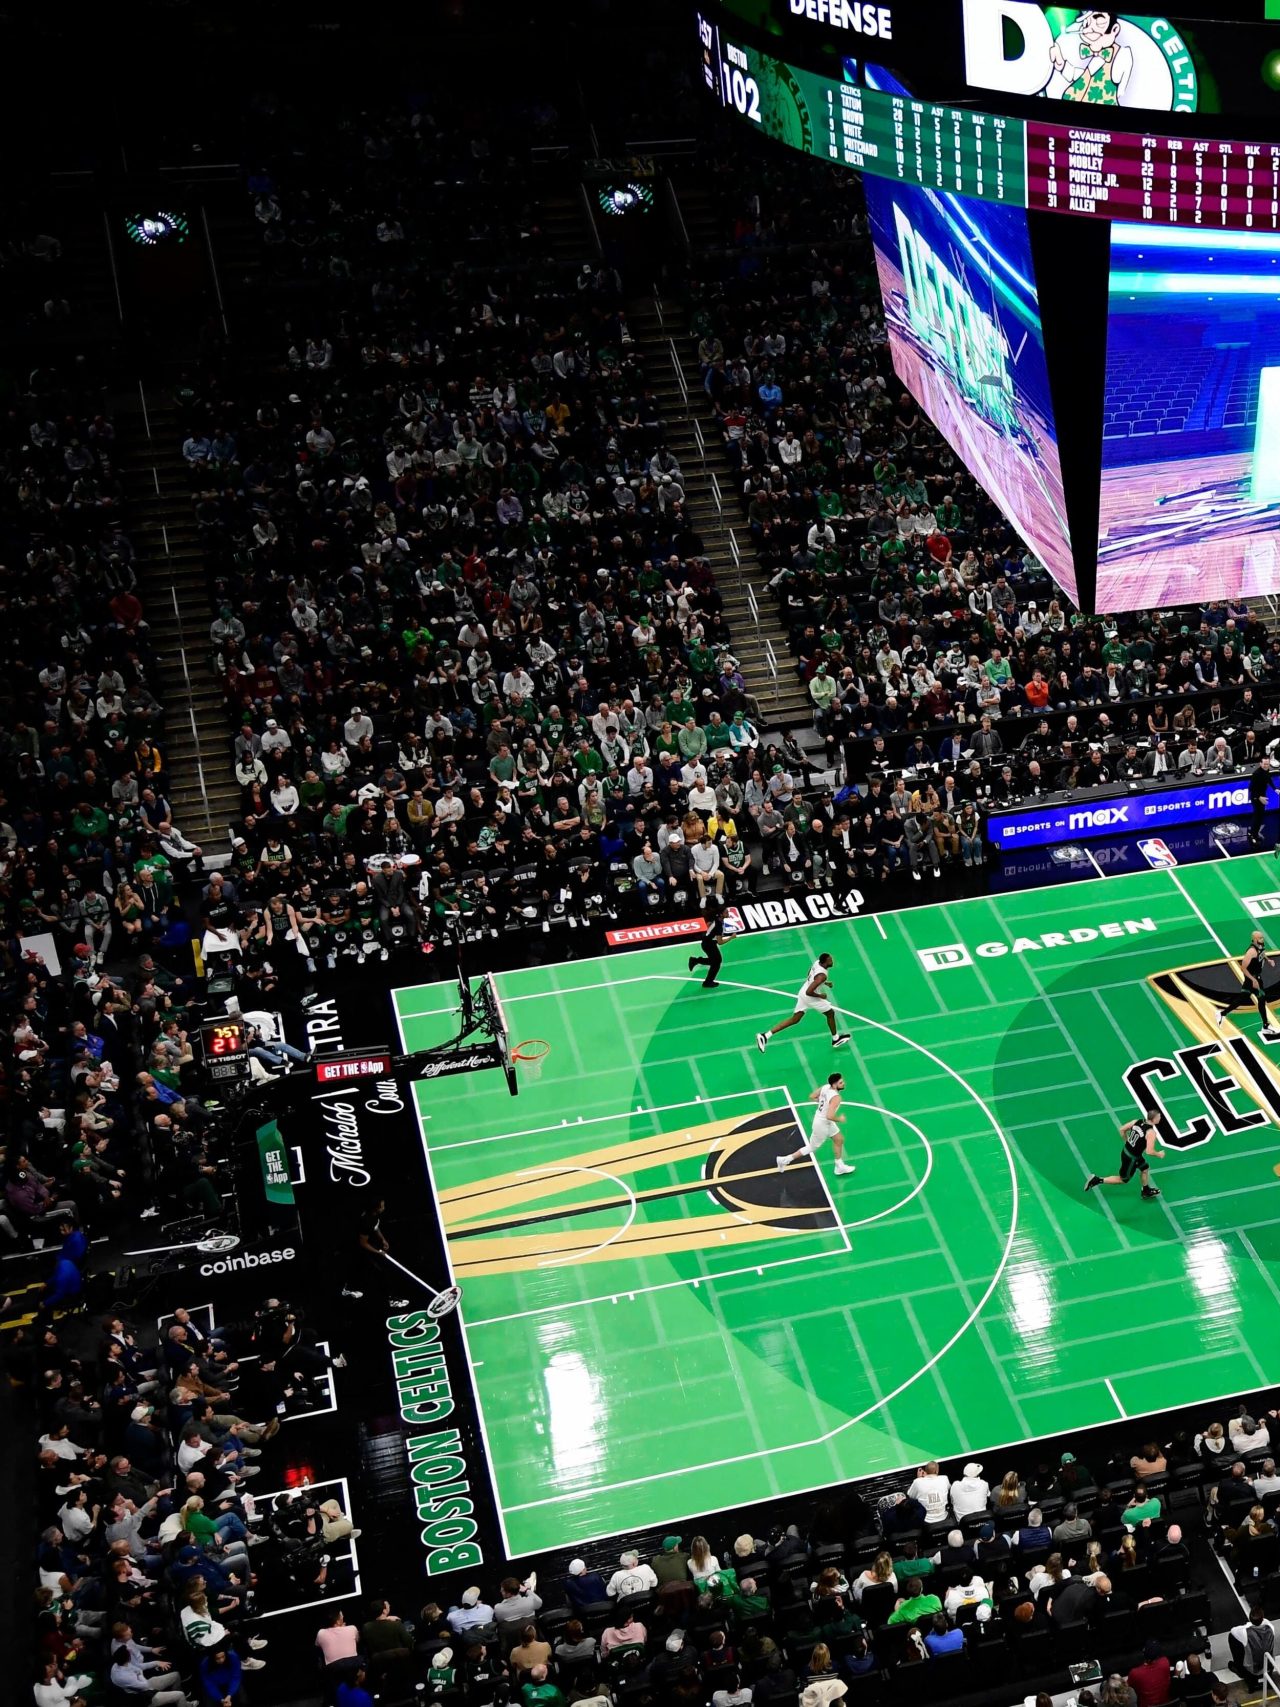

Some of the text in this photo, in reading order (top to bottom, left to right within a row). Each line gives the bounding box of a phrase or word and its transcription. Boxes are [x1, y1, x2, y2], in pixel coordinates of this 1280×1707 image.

[790, 0, 892, 40] DEFENSE
[723, 62, 762, 123] 102
[840, 85, 1005, 128] CELTICS PTS REB AST STL BLK FLS
[1048, 138, 1279, 170] 2 JEROME 8 1 5 1 0 2
[1069, 130, 1111, 143] CAVALIERS
[1142, 138, 1157, 148] PTS
[1168, 140, 1182, 150] REB
[1193, 142, 1209, 152] AST
[1219, 144, 1232, 154] STL
[1245, 146, 1260, 155] BLK
[1049, 152, 1277, 184] 4 MOBLEY 22 8 4 1 1 1
[1049, 167, 1277, 199] 9 PORTER JR. 12 3 3 0 0 1
[1048, 181, 1278, 214] 10 GARLAND 6 2 7 0 1 0
[1048, 195, 1276, 228] 31 ALLEN 10 11 2 1 0 1
[1158, 802, 1191, 812] SPORTS
[1209, 788, 1251, 809] ma
[1017, 822, 1051, 833] SPORTS
[1069, 806, 1129, 830] max
[742, 897, 806, 929] NBA
[613, 920, 701, 942] Emirates
[976, 918, 1157, 957] GARDEN
[213, 1038, 236, 1053] 21
[220, 1054, 246, 1062] TISSOT
[325, 1061, 384, 1078] GET THE App
[266, 1151, 280, 1162] GET
[320, 1101, 371, 1187] Michelob
[267, 1161, 283, 1173] THE
[273, 1173, 288, 1184] App
[200, 1248, 295, 1276] coinbase
[386, 1310, 484, 1577] BOSTON CELTICS
